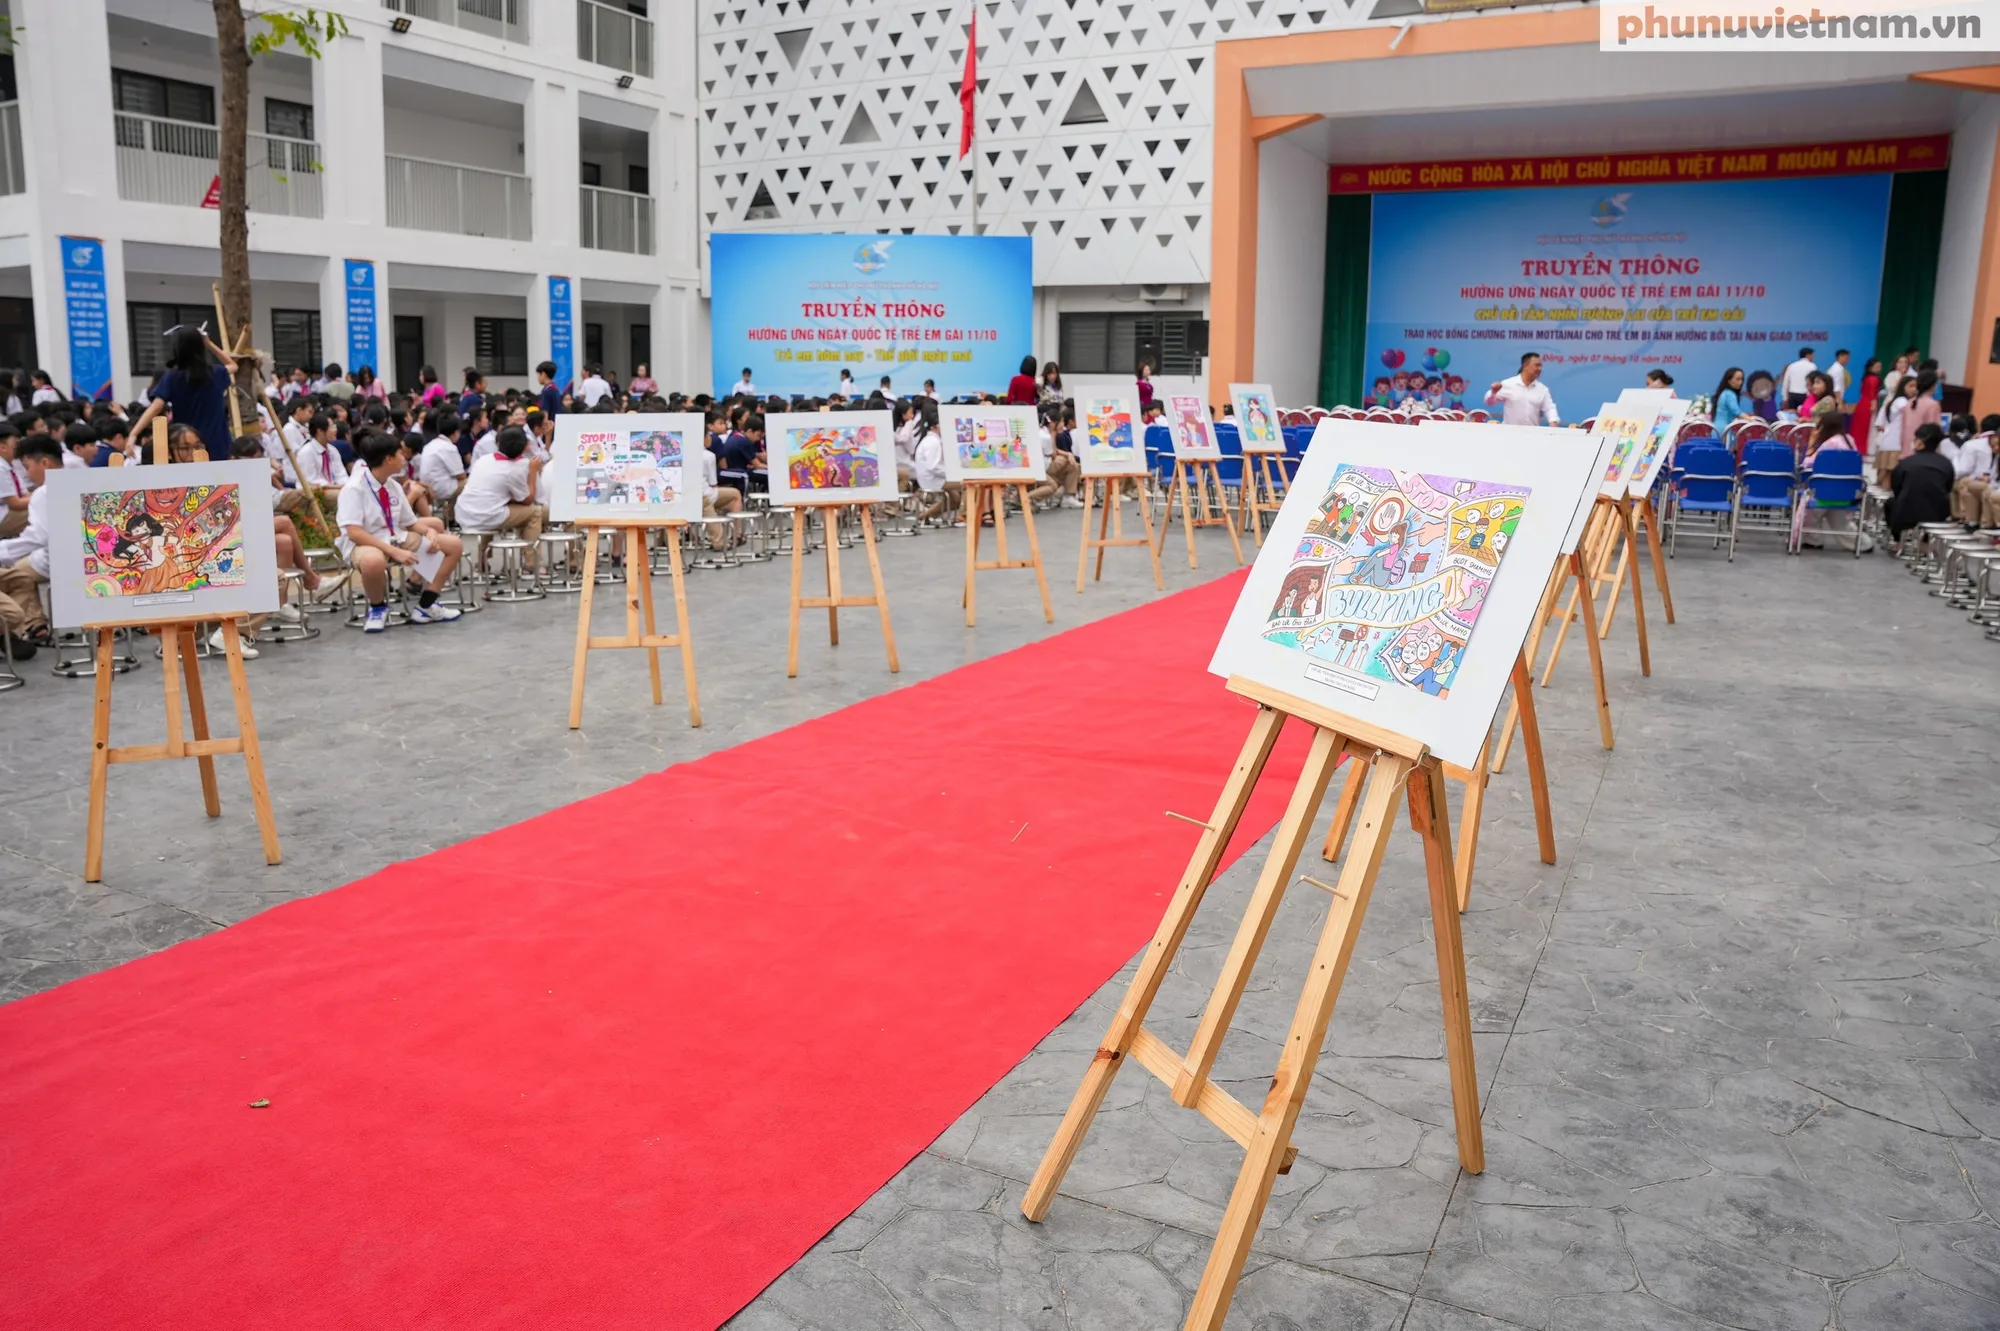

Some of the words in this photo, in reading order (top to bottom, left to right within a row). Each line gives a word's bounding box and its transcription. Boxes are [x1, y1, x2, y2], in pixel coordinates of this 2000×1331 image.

[1368, 165, 1412, 186] NƯỚC
[1420, 163, 1464, 188] CỘNG
[1472, 162, 1505, 183] HÒA
[1511, 160, 1534, 181] XÃ
[1541, 160, 1569, 184] HỘI
[1576, 156, 1610, 179] CHỦ
[1618, 155, 1671, 177] NGHĨA
[1677, 153, 1716, 179] VIỆT
[1721, 155, 1767, 174] NAM
[1846, 144, 1898, 167] NĂM
[1618, 253, 1701, 275] THÔNG
[1460, 283, 1505, 299] HƯỞNG
[1508, 284, 1536, 299] ỨNG
[1540, 284, 1576, 299] NGÀY
[1580, 281, 1616, 299] QUỐC
[1620, 282, 1637, 298] TẾ
[1641, 281, 1665, 298] TRẺ
[1670, 286, 1692, 298] EM
[1696, 284, 1720, 298] GÁI
[1726, 285, 1766, 298] 11/10
[882, 299, 946, 318] THÔNG
[1626, 308, 1647, 321] LAI
[1699, 308, 1719, 321] EM
[748, 326, 788, 341] HƯỞNG
[818, 326, 848, 341] NGÀY
[852, 325, 881, 342] QUỐC
[885, 325, 897, 341] TẾ
[901, 325, 921, 341] TRẺ
[924, 329, 941, 341] EM
[945, 328, 964, 341] GÁI
[967, 329, 998, 341] 11/10
[1404, 329, 1425, 339] TRAO
[1536, 330, 1583, 341] MOTTAINAI
[1585, 330, 1604, 340] CHO
[1625, 331, 1639, 341] EM
[1730, 331, 1743, 341] TAI
[1769, 331, 1793, 341] GIAO
[1796, 329, 1829, 342] THÔNG
[1663, 355, 1683, 365] 2024
[1400, 474, 1449, 513] STOP
